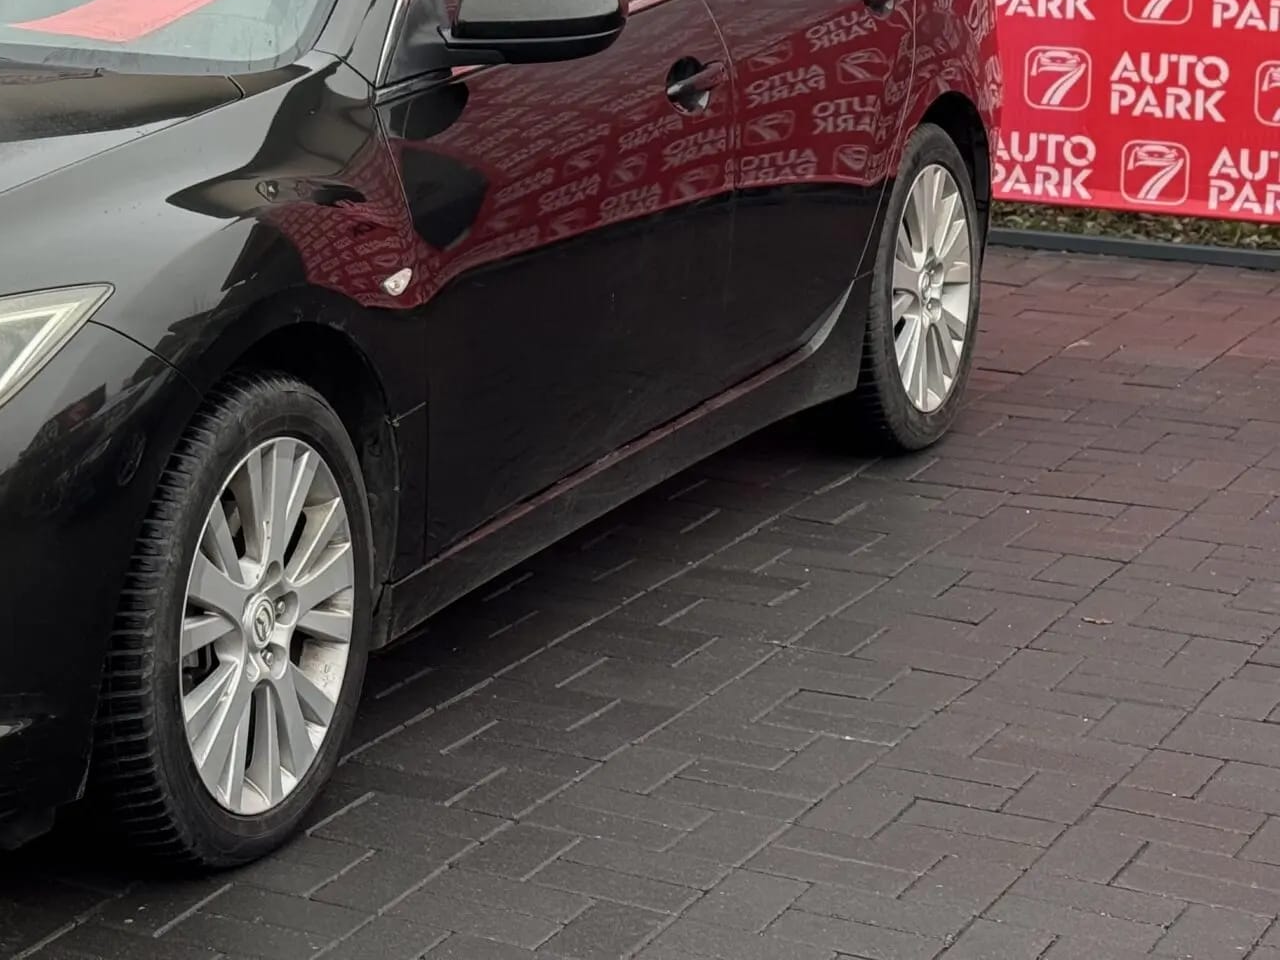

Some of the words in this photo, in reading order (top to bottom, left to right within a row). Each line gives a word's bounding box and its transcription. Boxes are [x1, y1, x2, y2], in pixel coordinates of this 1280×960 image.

[1110, 51, 1230, 89] AUTO
[1110, 83, 1226, 123] PARK
[994, 131, 1097, 168] AUTO
